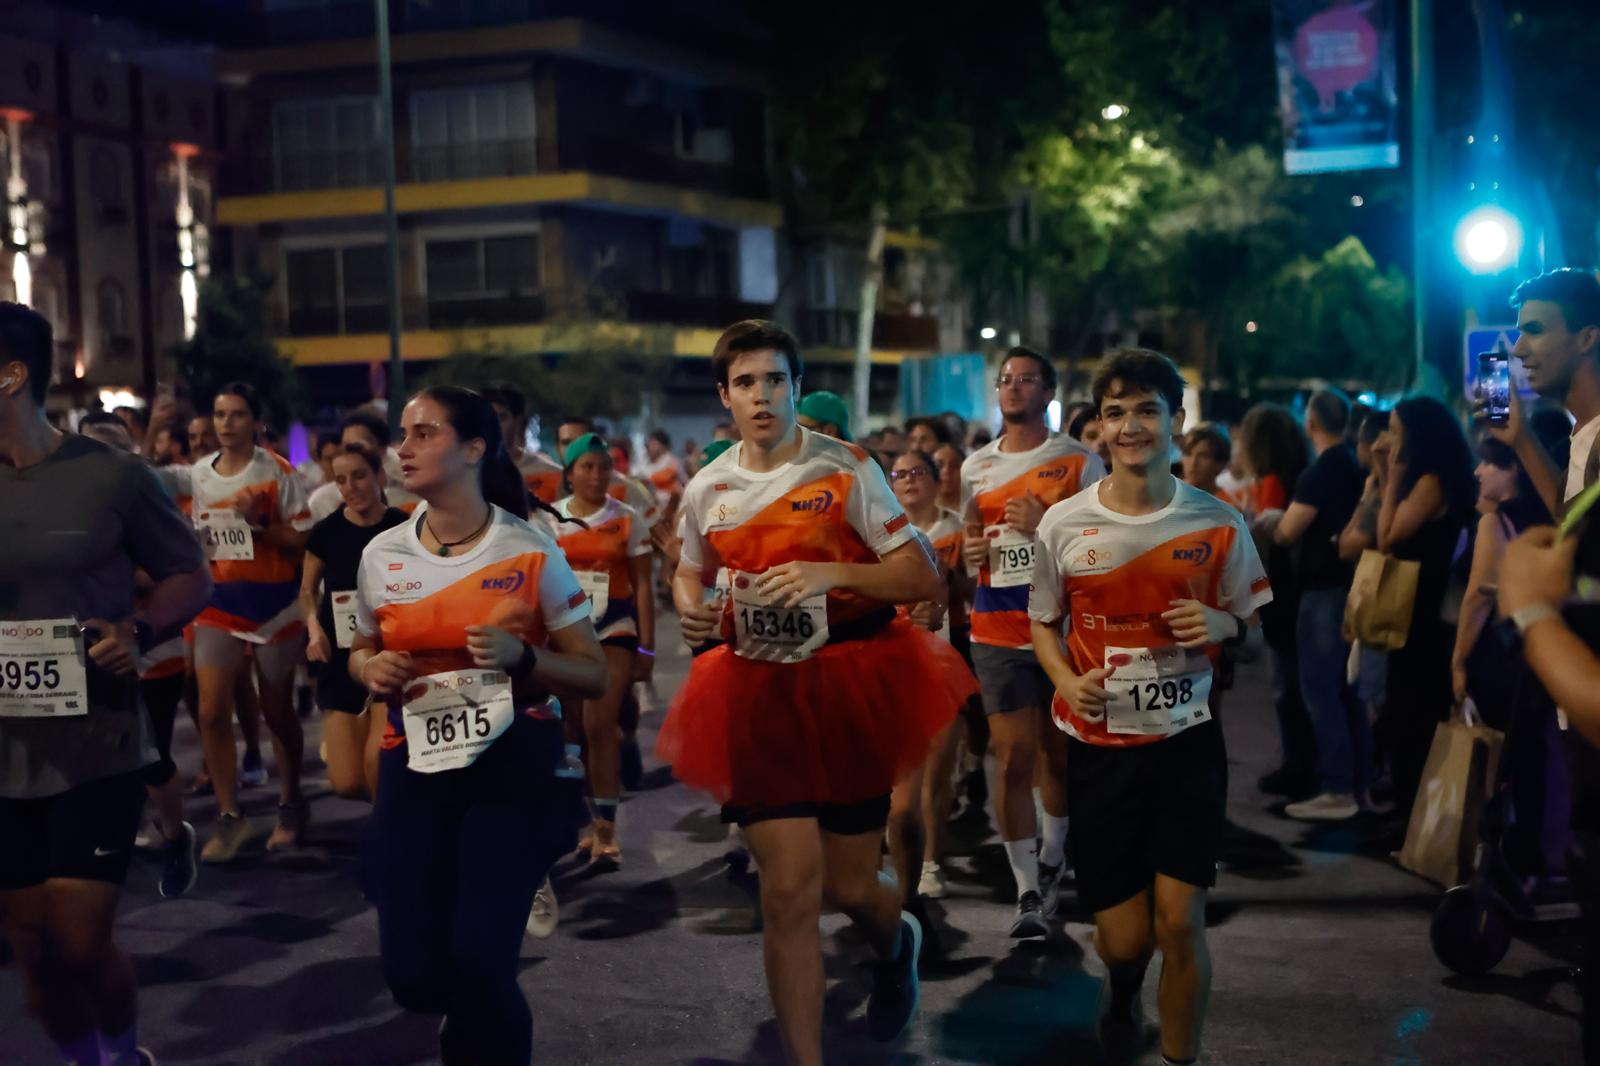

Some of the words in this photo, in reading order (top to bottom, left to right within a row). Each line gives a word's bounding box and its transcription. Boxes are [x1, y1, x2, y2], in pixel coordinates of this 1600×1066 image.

[793, 494, 829, 513] KH7
[1173, 545, 1209, 564] KH7
[741, 608, 813, 638] 15346
[1082, 614, 1106, 632] 37
[1128, 678, 1192, 711] 1298
[427, 708, 490, 746] 6615
